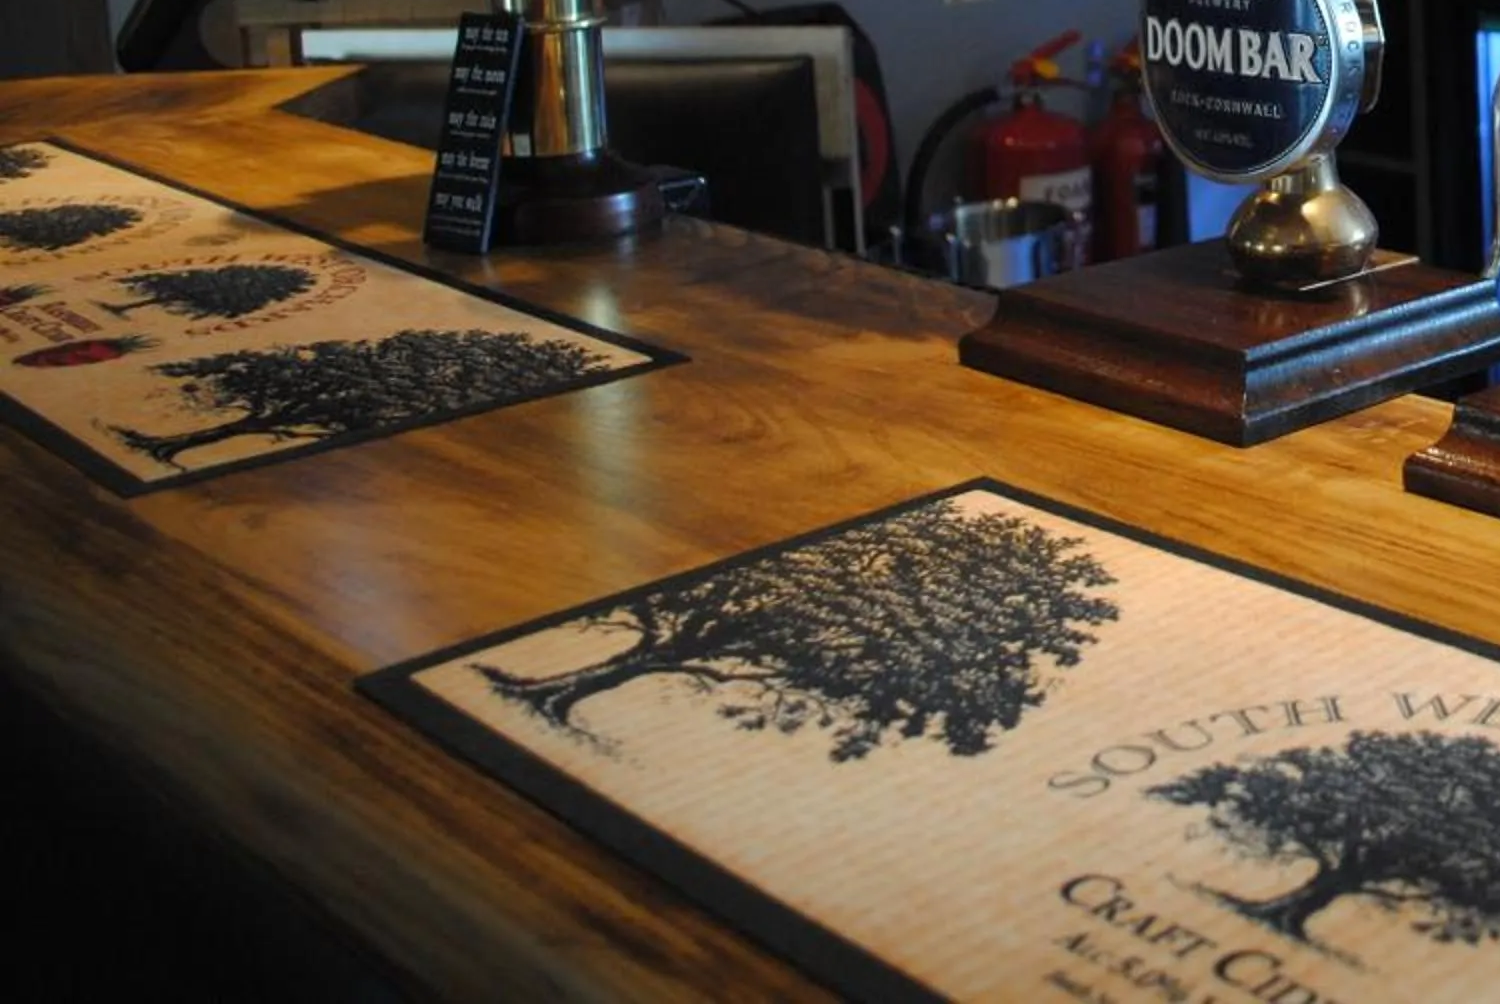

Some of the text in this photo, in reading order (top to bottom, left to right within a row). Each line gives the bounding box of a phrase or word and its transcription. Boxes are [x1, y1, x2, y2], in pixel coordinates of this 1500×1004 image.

[1146, 15, 1323, 84] DOOM BAR
[1046, 695, 1345, 799] SOUTH
[1060, 873, 1218, 959] CRAFT
[1213, 948, 1335, 1004] CID
